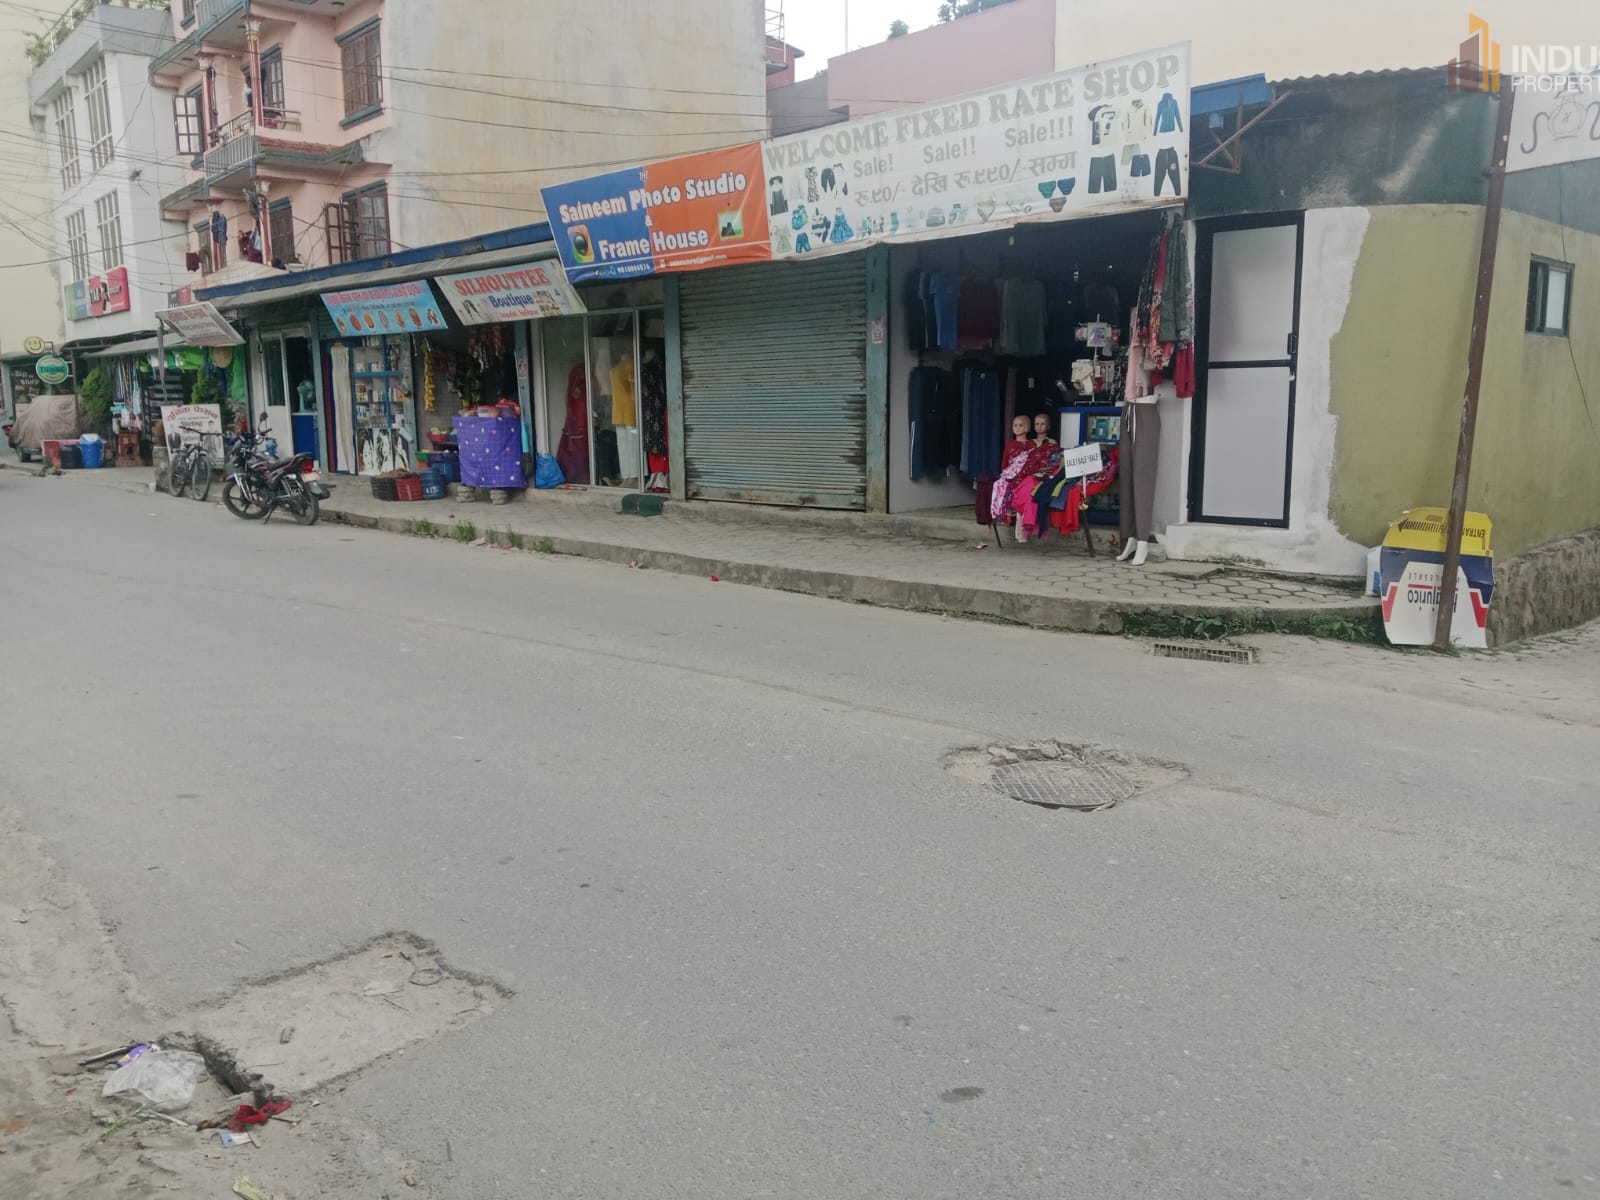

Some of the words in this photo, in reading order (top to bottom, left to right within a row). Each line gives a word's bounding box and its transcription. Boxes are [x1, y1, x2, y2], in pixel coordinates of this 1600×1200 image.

[765, 121, 889, 171] WELCOME
[896, 100, 981, 143] FIXED
[988, 78, 1074, 123] RATE
[1083, 54, 1180, 102] SHOP
[853, 153, 894, 178] Sale!
[923, 135, 976, 164] Sale!!
[1005, 115, 1074, 148] Sale!!!
[559, 194, 627, 224] Saineem
[629, 184, 681, 211] Photo
[685, 172, 748, 201] Studio
[912, 171, 948, 197] देखि
[645, 215, 653, 227] &
[598, 237, 650, 260] Frame
[653, 228, 709, 253] House
[488, 292, 535, 310] Boutique
